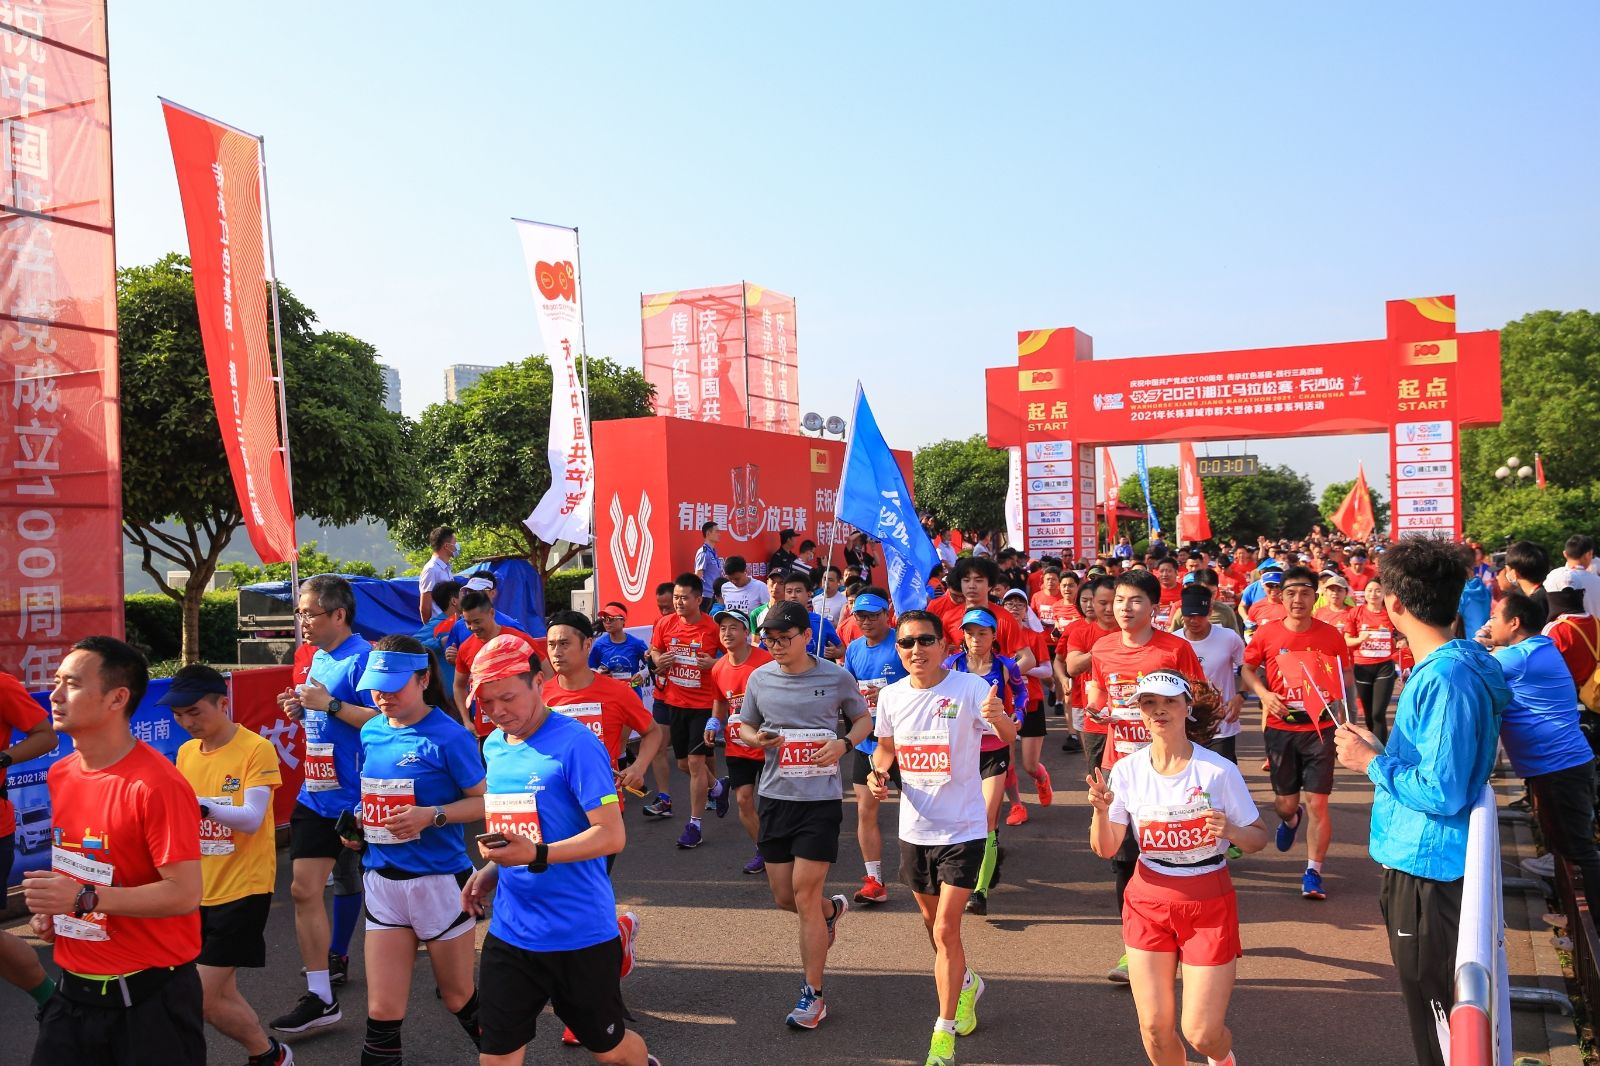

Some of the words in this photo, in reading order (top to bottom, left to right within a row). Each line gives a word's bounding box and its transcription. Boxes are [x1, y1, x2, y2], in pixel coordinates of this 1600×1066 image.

[1398, 377, 1448, 399] 起点
[1028, 401, 1068, 421] 起点
[1398, 400, 1448, 411] START
[1028, 422, 1068, 432] START
[678, 501, 728, 531] 有能量
[767, 505, 807, 532] 放马来
[668, 664, 701, 680] A10452
[130, 719, 171, 742] 指南
[897, 751, 949, 770] A12209
